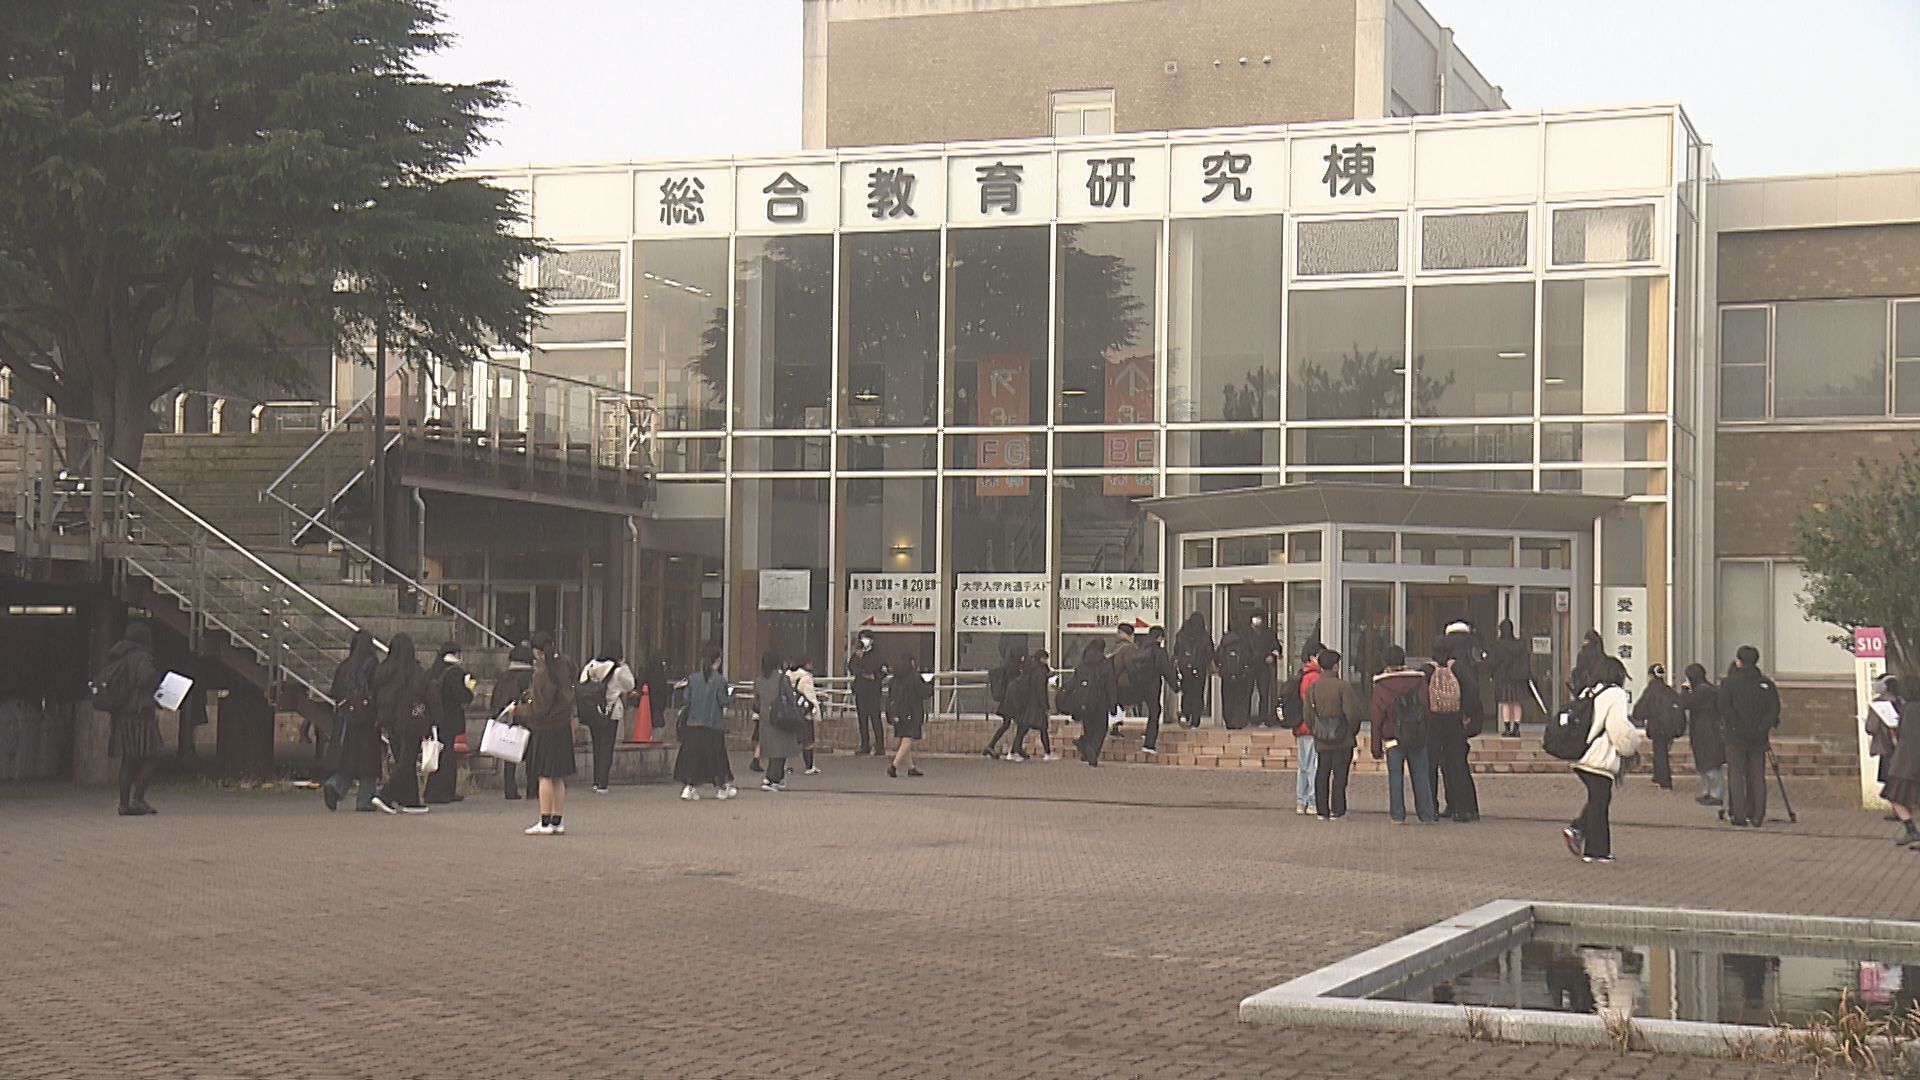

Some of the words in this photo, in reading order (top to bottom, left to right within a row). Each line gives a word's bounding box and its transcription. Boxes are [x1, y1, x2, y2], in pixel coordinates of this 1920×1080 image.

[660, 143, 1377, 226] 総合教育研究棟
[962, 581, 1047, 592] 大学入学共通テスト
[963, 615, 1002, 626] ください。
[1858, 637, 1882, 652] S10
